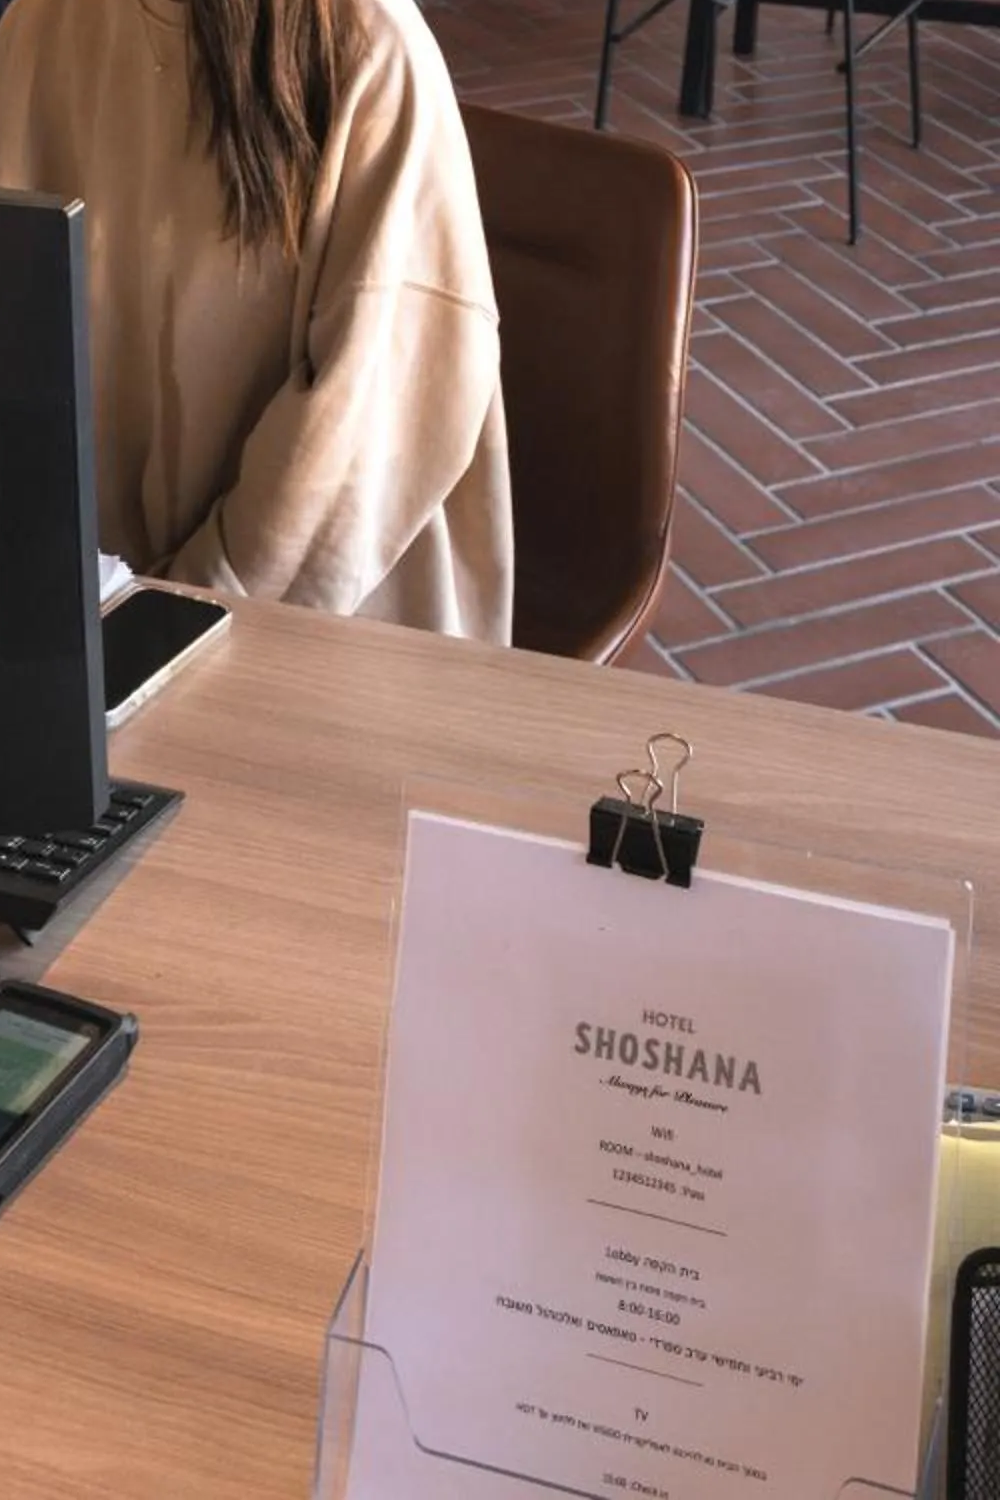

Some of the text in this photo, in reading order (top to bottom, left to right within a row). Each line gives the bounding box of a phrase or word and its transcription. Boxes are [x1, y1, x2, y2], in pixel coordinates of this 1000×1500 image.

[642, 1010, 697, 1033] HOTEL
[574, 1021, 762, 1095] SHOSHANA
[600, 1140, 633, 1157] ROOM
[643, 1257, 677, 1276] הקפה
[679, 1267, 700, 1281] בית
[634, 1407, 649, 1423] TV
